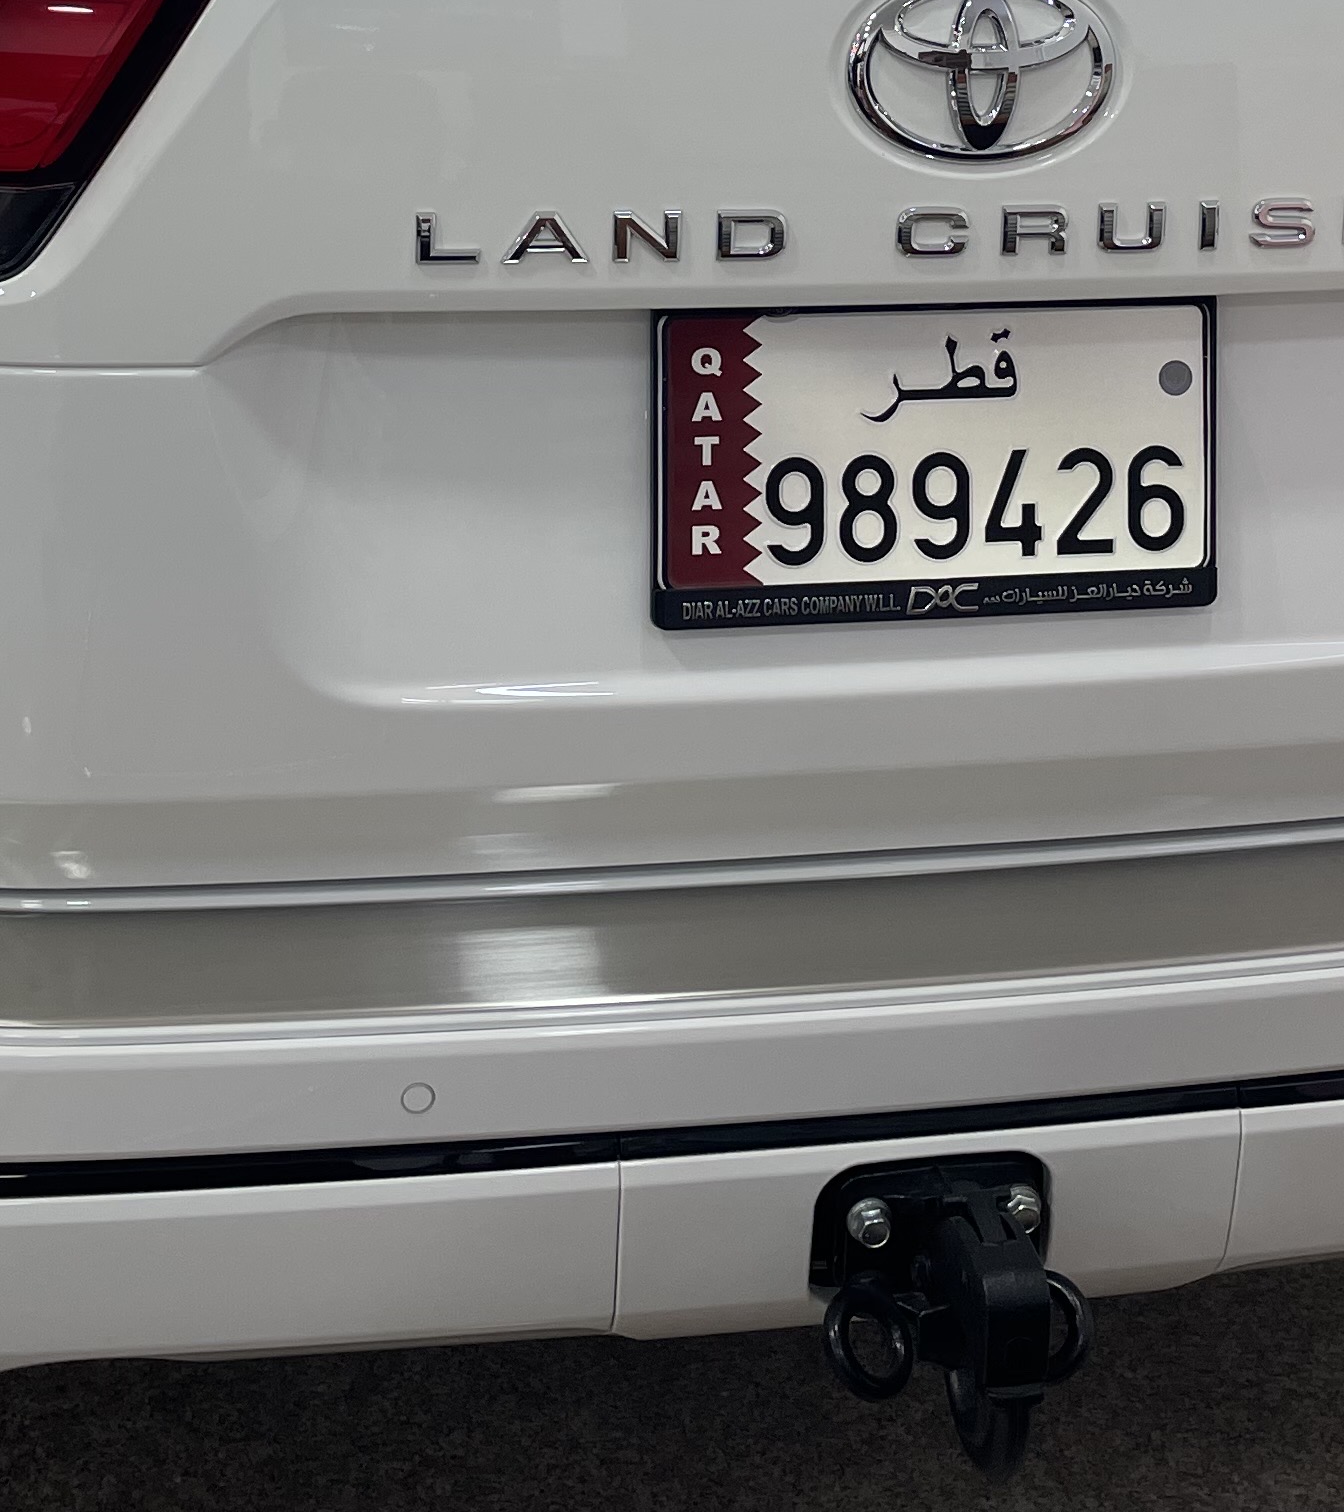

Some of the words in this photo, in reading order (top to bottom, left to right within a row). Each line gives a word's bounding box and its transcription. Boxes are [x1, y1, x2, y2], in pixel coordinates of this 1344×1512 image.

[413, 207, 789, 265] LAND
[859, 327, 1019, 424] قطر
[690, 346, 724, 556] QATAR
[763, 443, 1187, 567] 989426
[681, 600, 713, 621] DIAR
[715, 598, 761, 619] AL-AZZ
[763, 597, 799, 617] CARS
[800, 594, 864, 615] COMPANY
[1106, 582, 1141, 600] ديار
[1143, 577, 1193, 598] شركة
